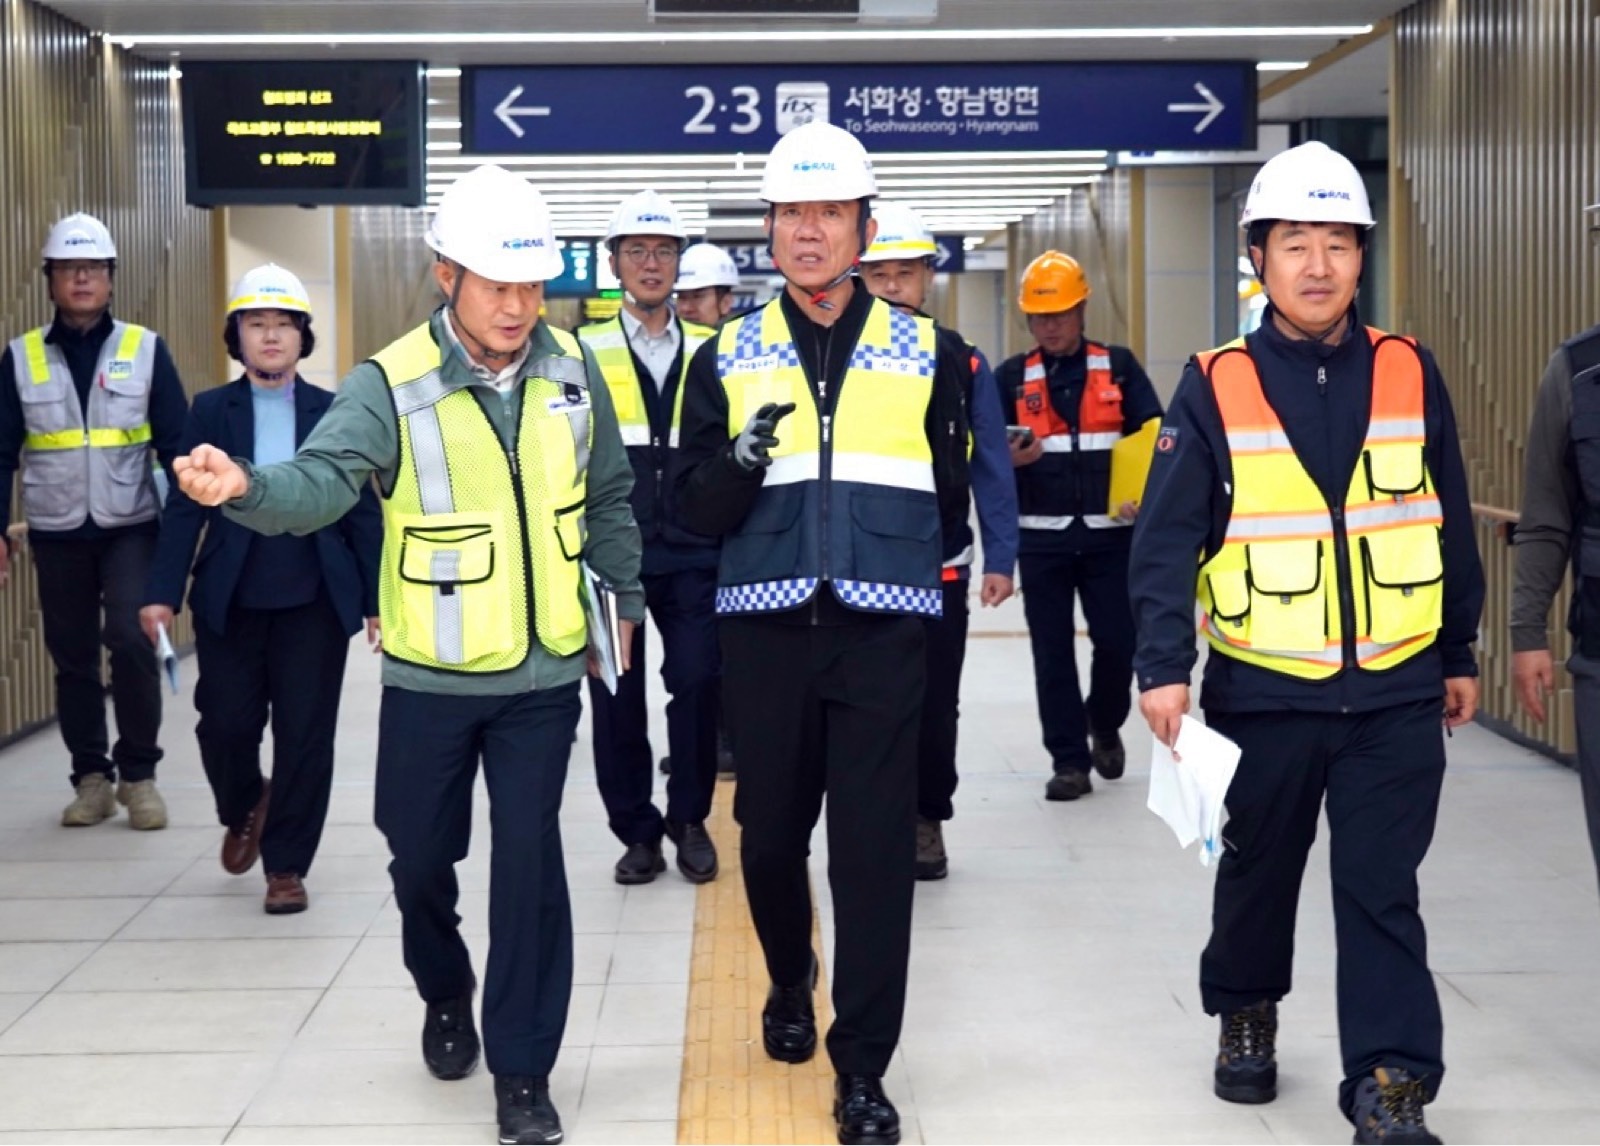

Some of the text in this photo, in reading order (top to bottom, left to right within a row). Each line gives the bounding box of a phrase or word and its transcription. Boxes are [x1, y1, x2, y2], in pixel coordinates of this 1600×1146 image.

[844, 118, 862, 133] To
[792, 160, 837, 171] KORAIL
[1308, 188, 1351, 200] KORAIL
[502, 238, 545, 250] KORAIL
